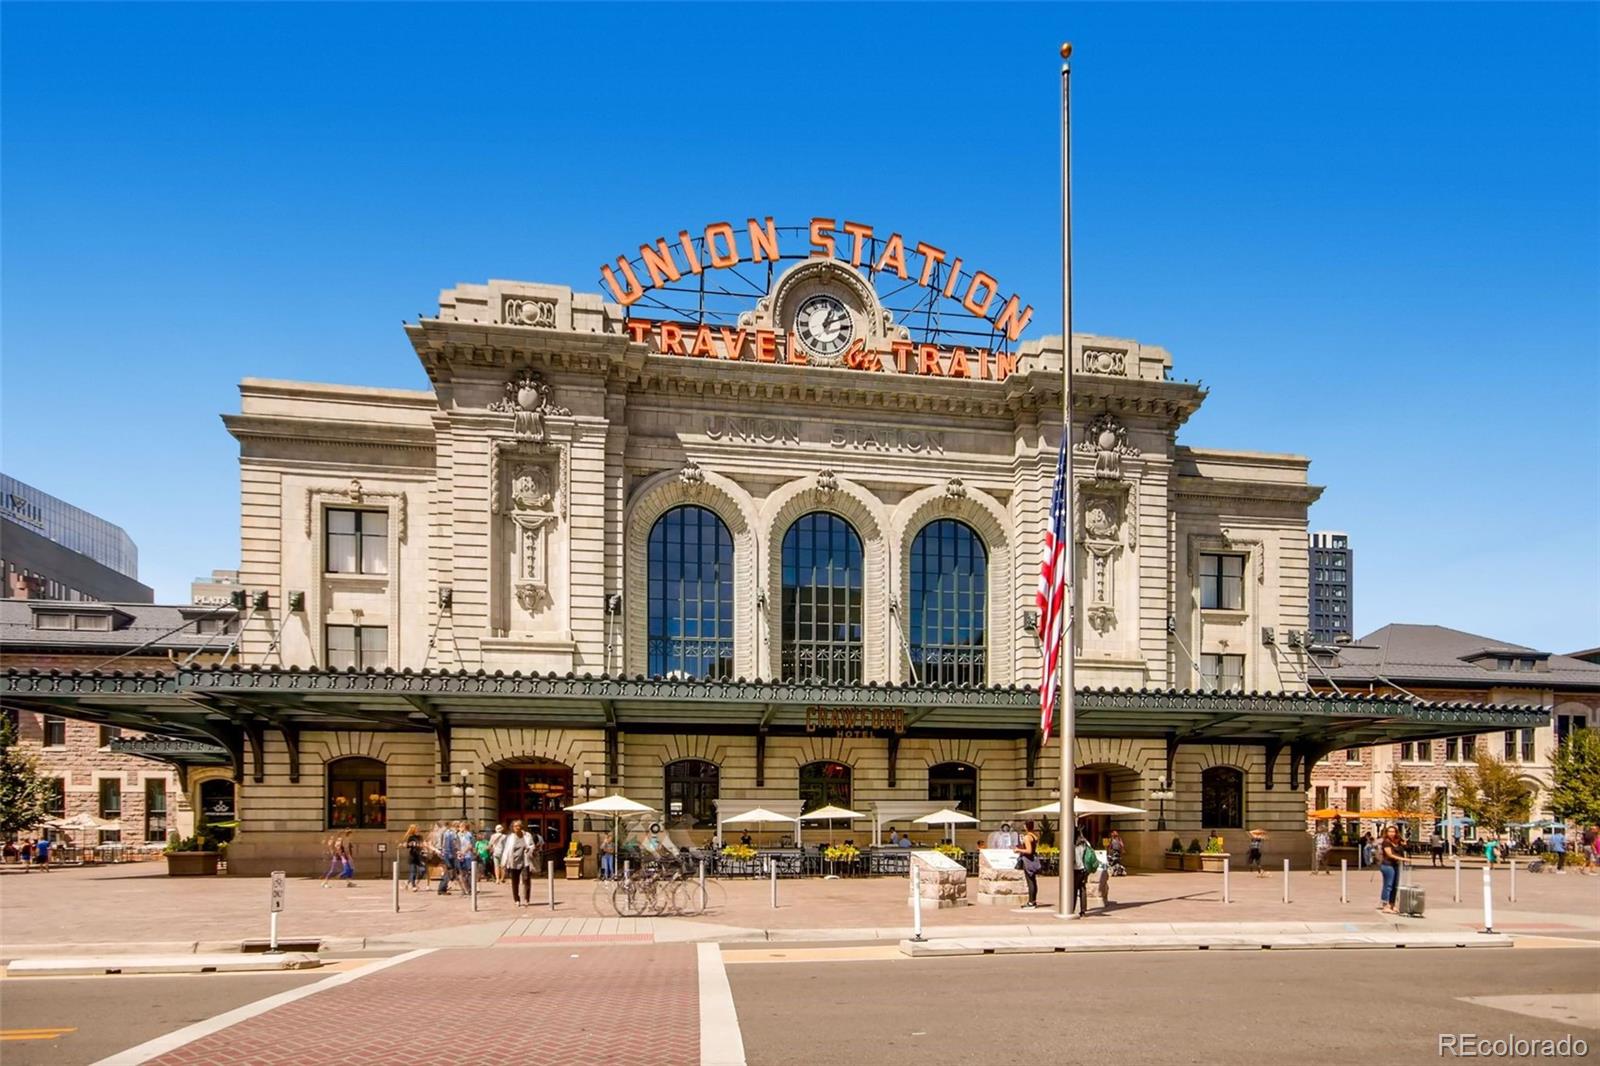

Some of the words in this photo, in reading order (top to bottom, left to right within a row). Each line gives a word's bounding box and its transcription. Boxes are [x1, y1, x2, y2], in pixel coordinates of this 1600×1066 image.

[600, 216, 779, 306] UNION
[809, 217, 1034, 342] STATION
[628, 318, 808, 364] TRAVEL
[891, 341, 1018, 380] TRAIN
[703, 416, 800, 445] UNION
[830, 425, 944, 455] STATION
[806, 706, 904, 734] CRAWFORD
[836, 730, 875, 738] HOTEL
